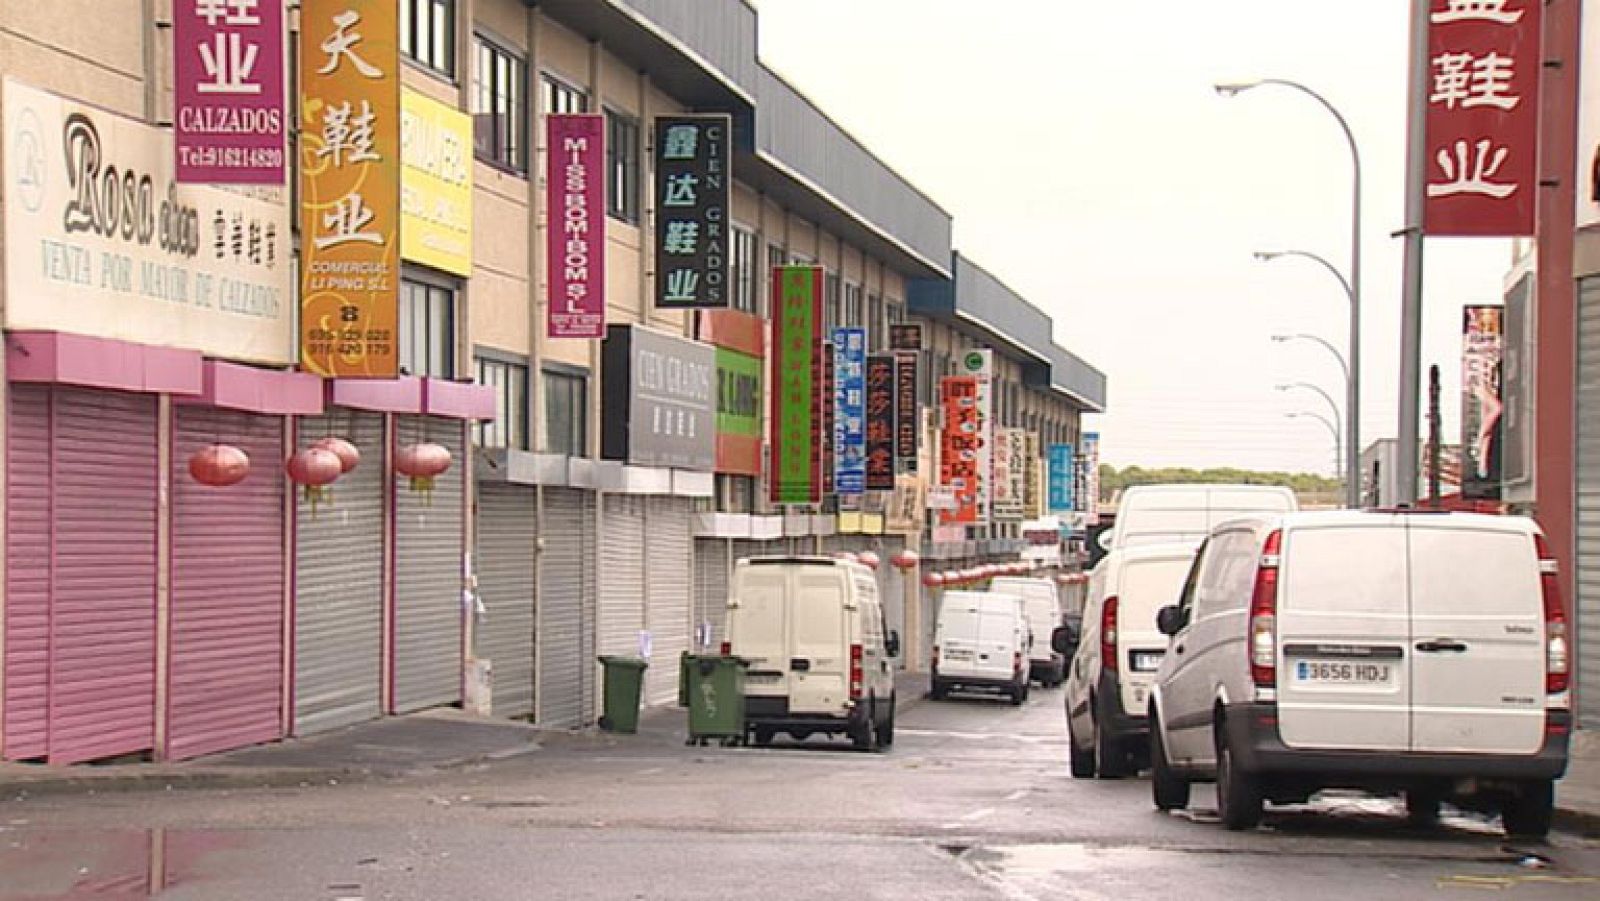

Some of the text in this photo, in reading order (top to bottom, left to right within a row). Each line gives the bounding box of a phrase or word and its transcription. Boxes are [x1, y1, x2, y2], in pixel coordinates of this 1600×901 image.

[179, 106, 281, 135] CALZADOS
[315, 9, 386, 249] 天鞋业
[705, 126, 722, 300] CIEN GRADOS
[41, 239, 91, 285] VENTA
[101, 252, 132, 293] POR
[195, 272, 214, 308] DE
[1355, 664, 1388, 682] HDJ
